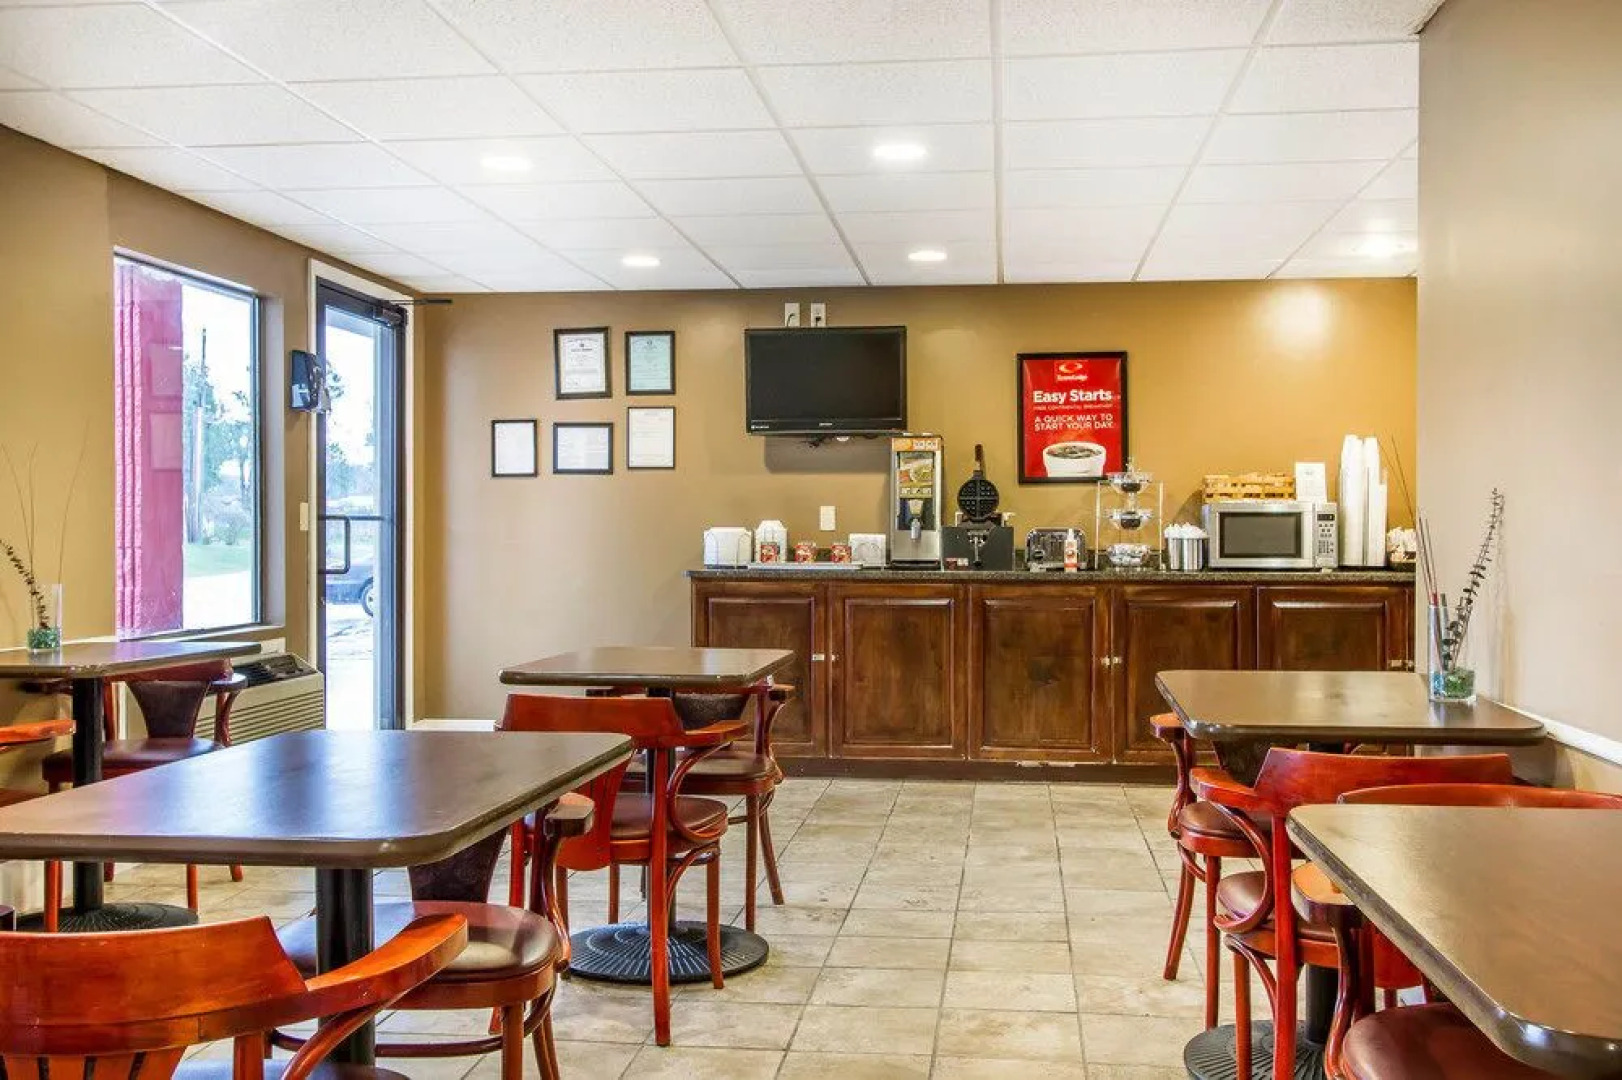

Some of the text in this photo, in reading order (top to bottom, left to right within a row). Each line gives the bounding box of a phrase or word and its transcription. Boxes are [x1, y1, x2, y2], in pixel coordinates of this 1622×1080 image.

[1033, 388, 1112, 405] Easy Starts
[1100, 413, 1113, 421] TO
[1035, 422, 1063, 431] START
[1066, 421, 1092, 430] YOUR
